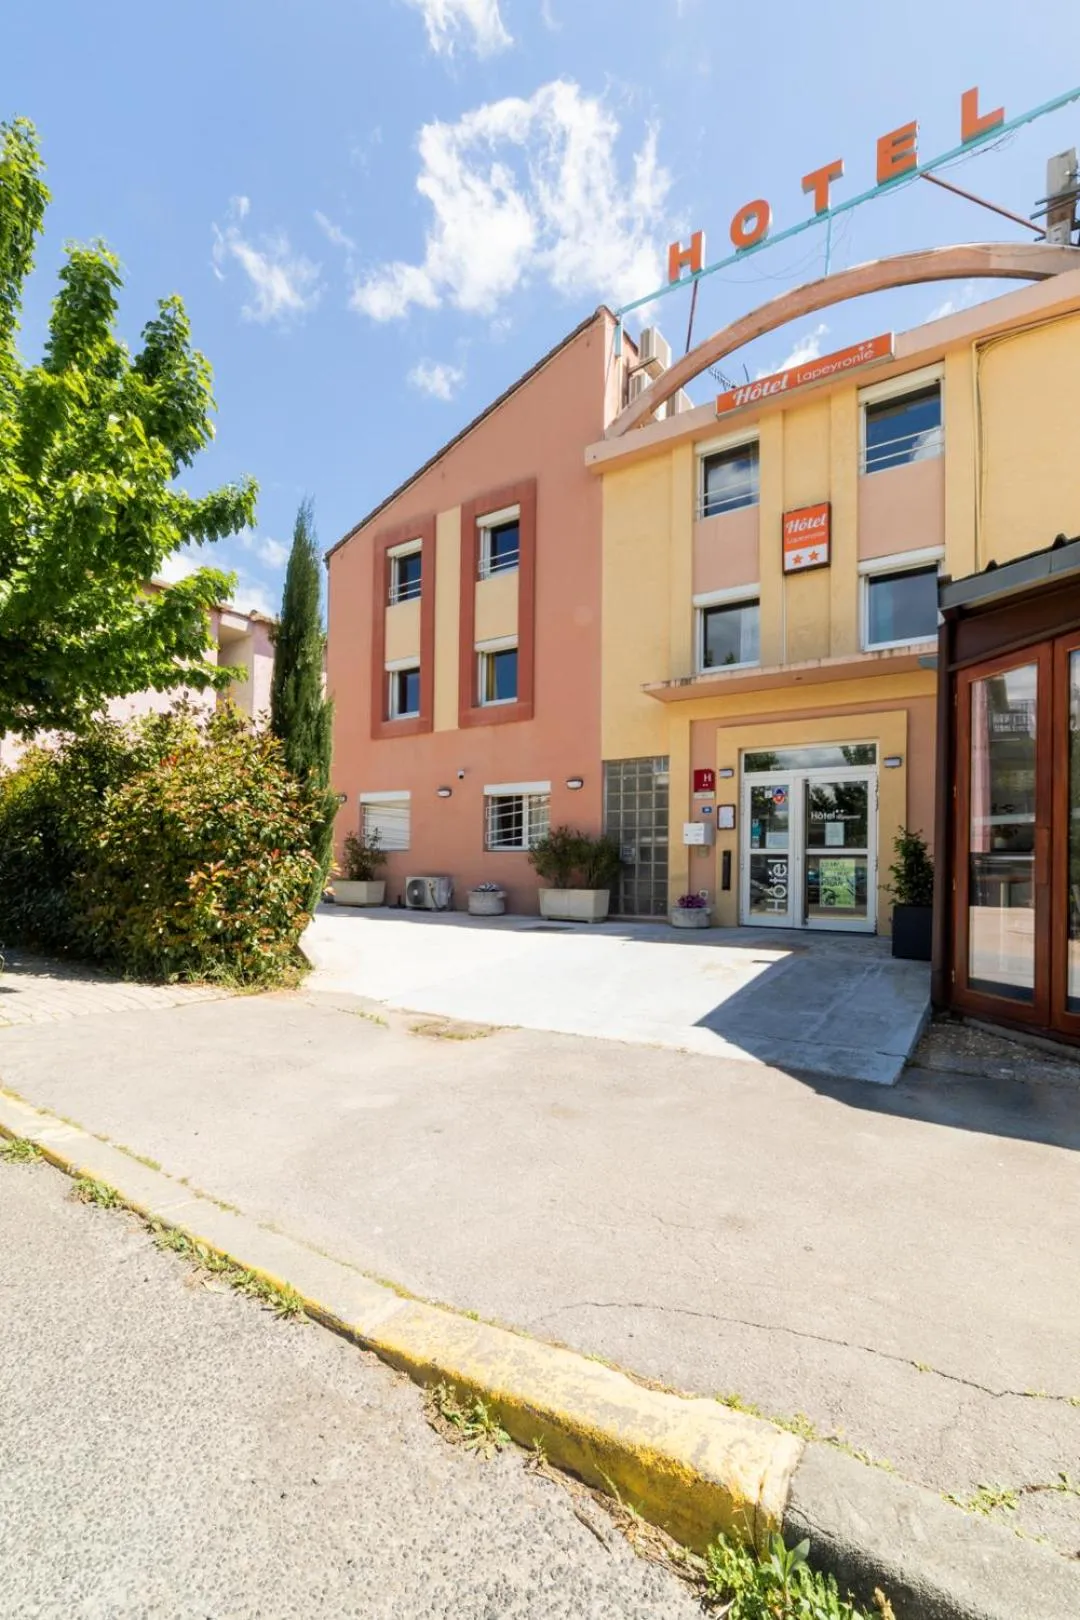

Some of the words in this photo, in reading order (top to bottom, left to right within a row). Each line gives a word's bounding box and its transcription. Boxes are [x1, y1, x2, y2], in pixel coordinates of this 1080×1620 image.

[668, 86, 1004, 283] HOTEL
[733, 372, 789, 406] Hôtel
[786, 512, 828, 534] Hôtel
[703, 773, 712, 782] H
[764, 858, 788, 913] Hôtel
